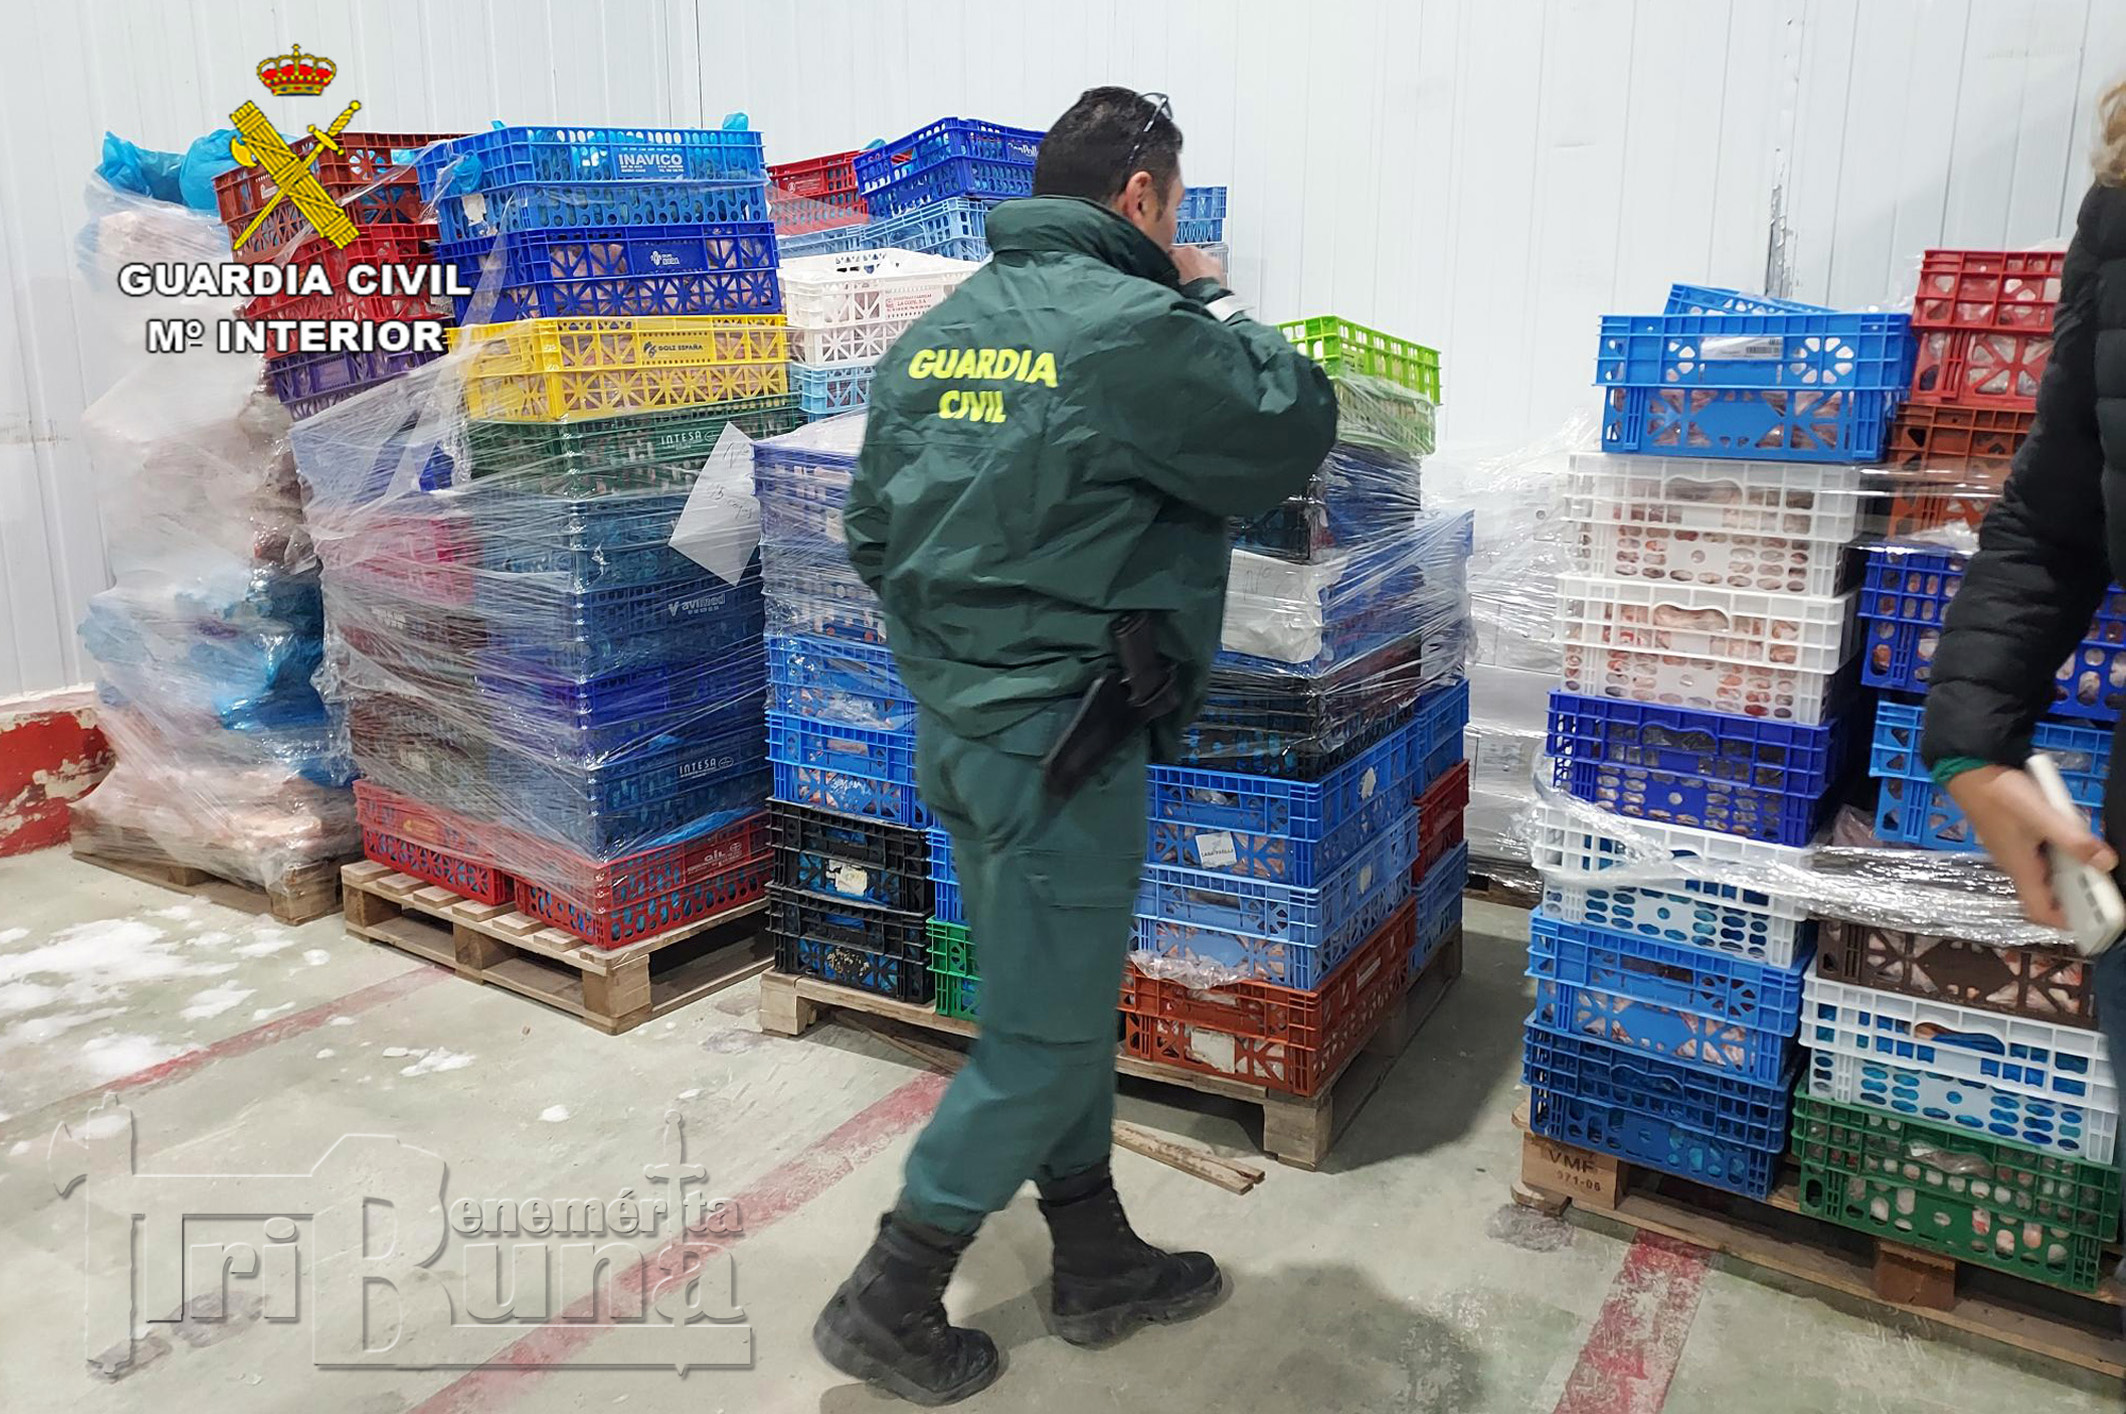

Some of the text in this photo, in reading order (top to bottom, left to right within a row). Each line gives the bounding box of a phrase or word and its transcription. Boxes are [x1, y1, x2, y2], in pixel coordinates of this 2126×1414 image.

[618, 153, 683, 165] INAVICO
[908, 348, 1059, 388] GUARDIA
[938, 390, 1007, 423] CIVIL
[660, 431, 702, 445] INTESA
[680, 758, 716, 774] INTESA
